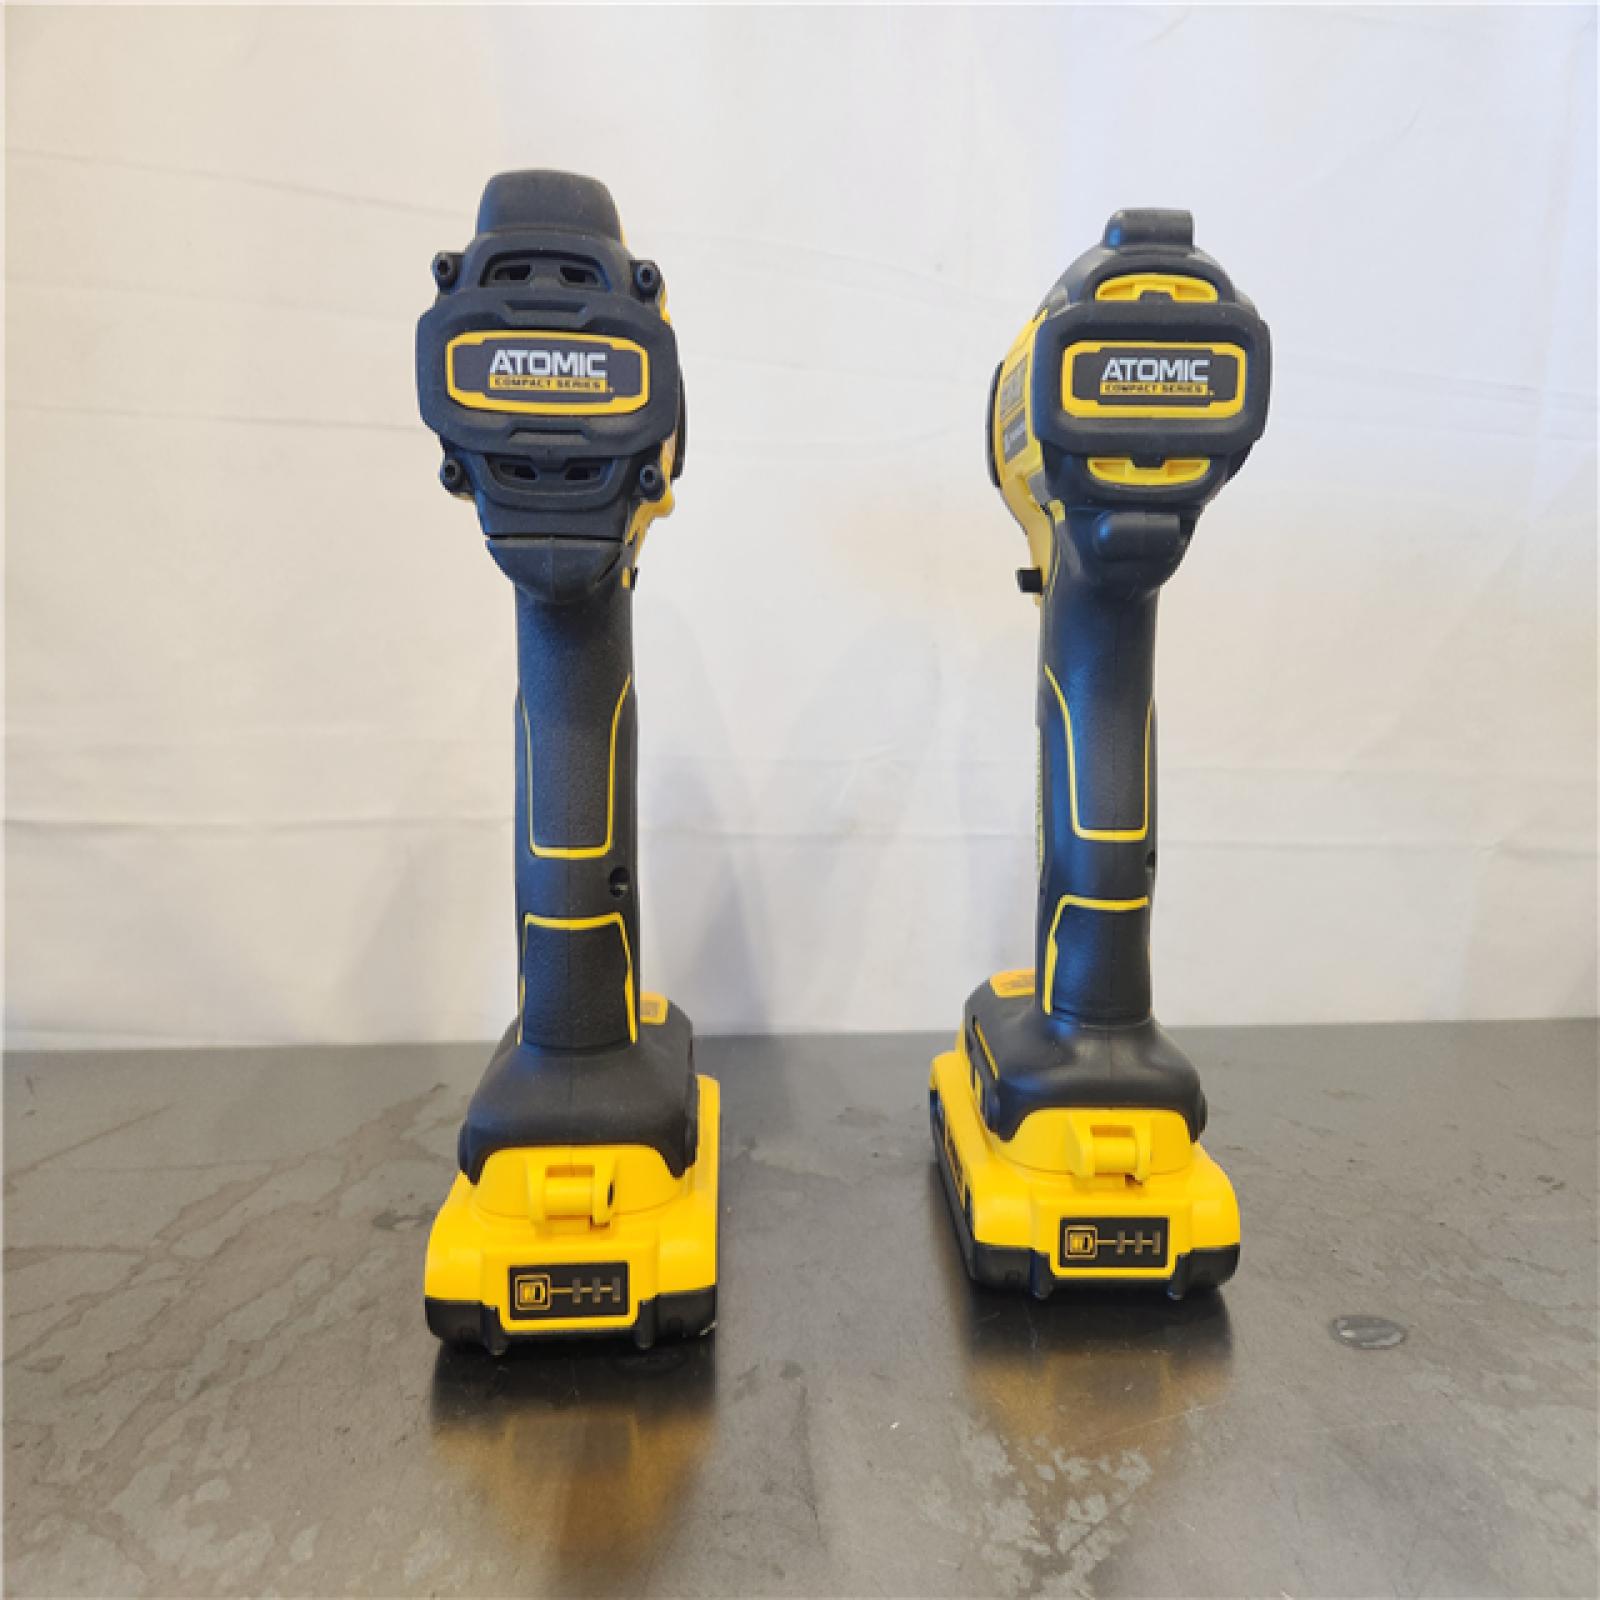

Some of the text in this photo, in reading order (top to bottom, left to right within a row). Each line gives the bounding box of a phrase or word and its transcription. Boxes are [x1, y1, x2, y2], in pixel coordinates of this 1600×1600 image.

[489, 349, 608, 378] ATOMIC
[1101, 357, 1210, 382] ATOMIC
[493, 377, 601, 390] COMPACT SERIES
[1104, 383, 1204, 393] COMPACT SERIES
